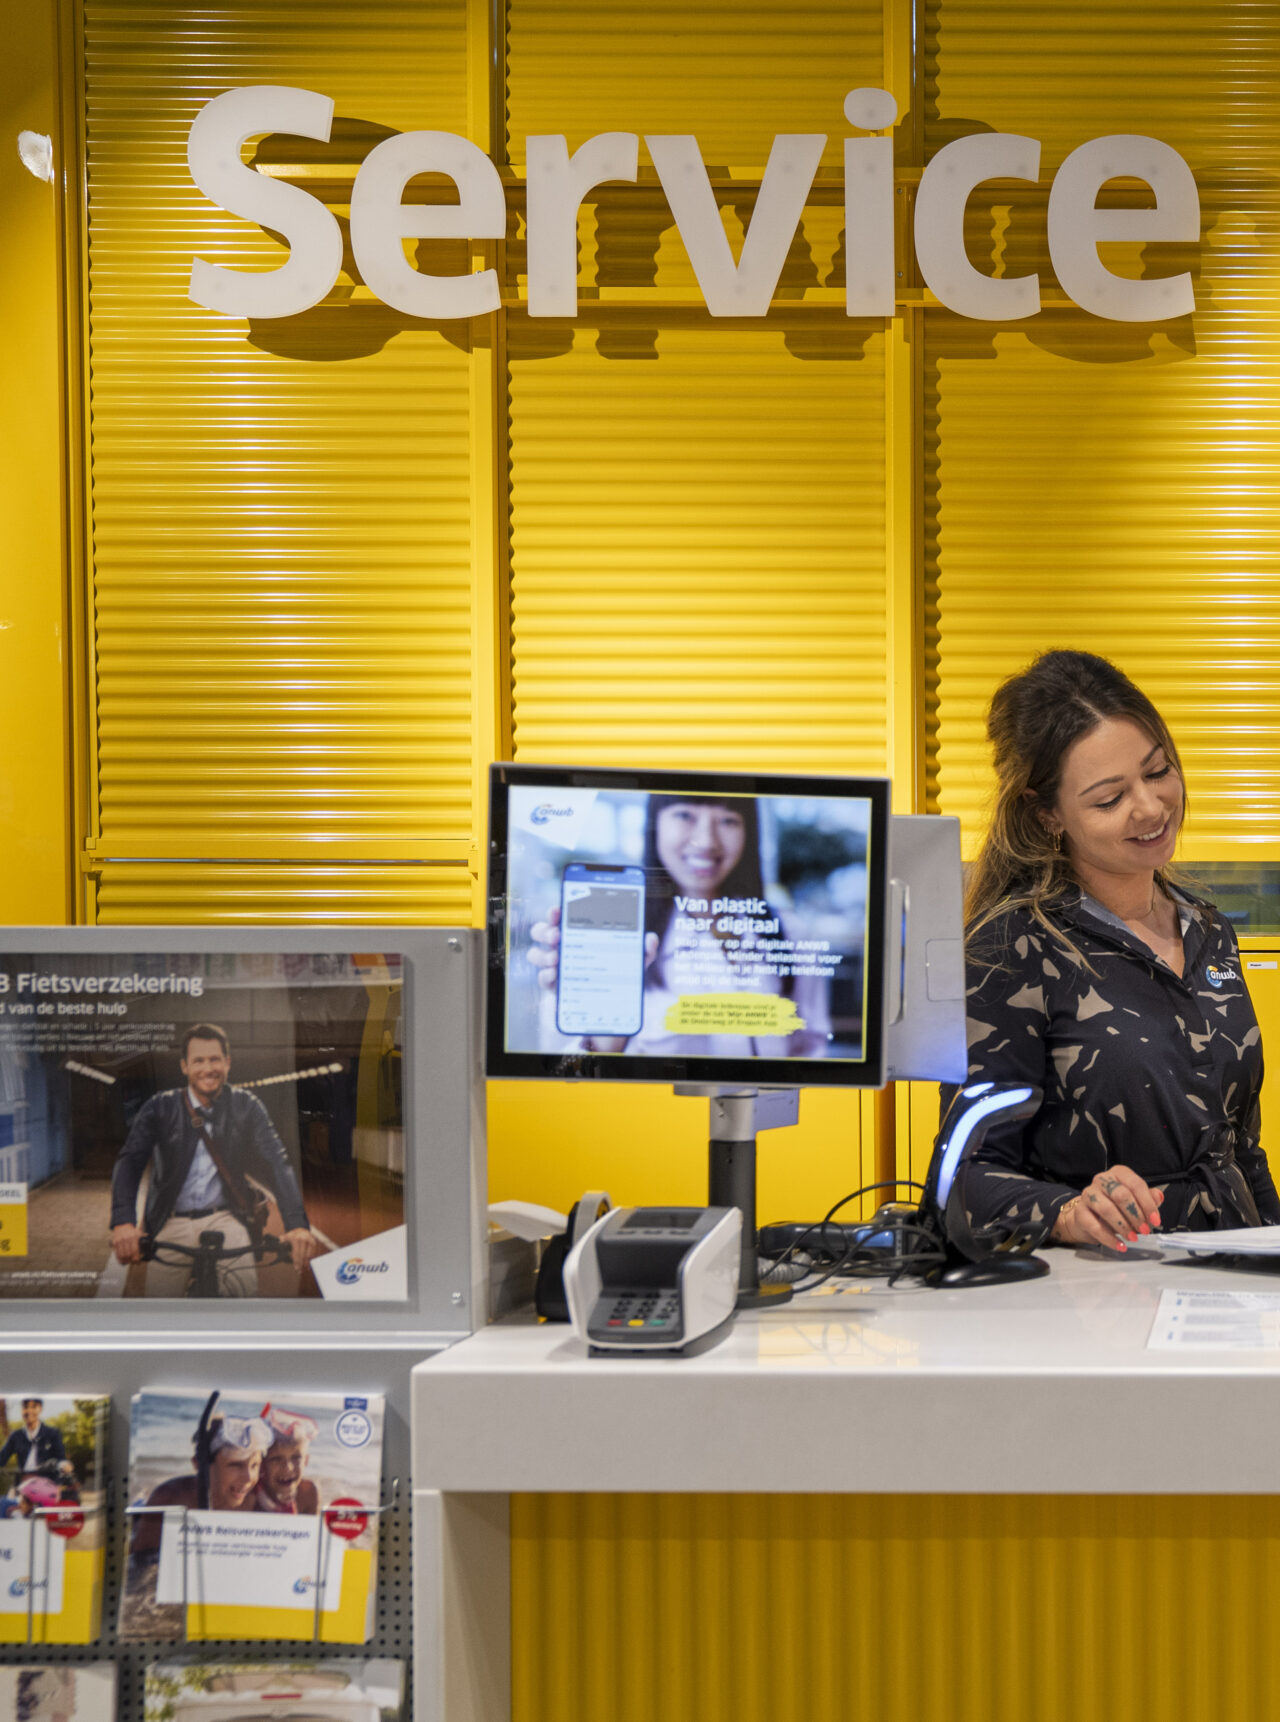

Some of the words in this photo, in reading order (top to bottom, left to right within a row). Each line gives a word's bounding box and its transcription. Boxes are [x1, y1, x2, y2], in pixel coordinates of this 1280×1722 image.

[188, 86, 1201, 322] Service
[674, 896, 708, 912] Van
[712, 897, 767, 915] plastic
[675, 918, 714, 932] naar
[716, 917, 780, 935] digitaal
[818, 955, 843, 964] voor
[1210, 968, 1236, 979] anwb
[17, 972, 204, 997] Fietsverzekering
[8, 1003, 35, 1015] van
[37, 1002, 55, 1015] de
[57, 1002, 94, 1015] beste
[97, 1002, 128, 1017] hulp
[347, 1260, 390, 1273] anwb
[216, 1525, 311, 1540] Reisverzekeringen
